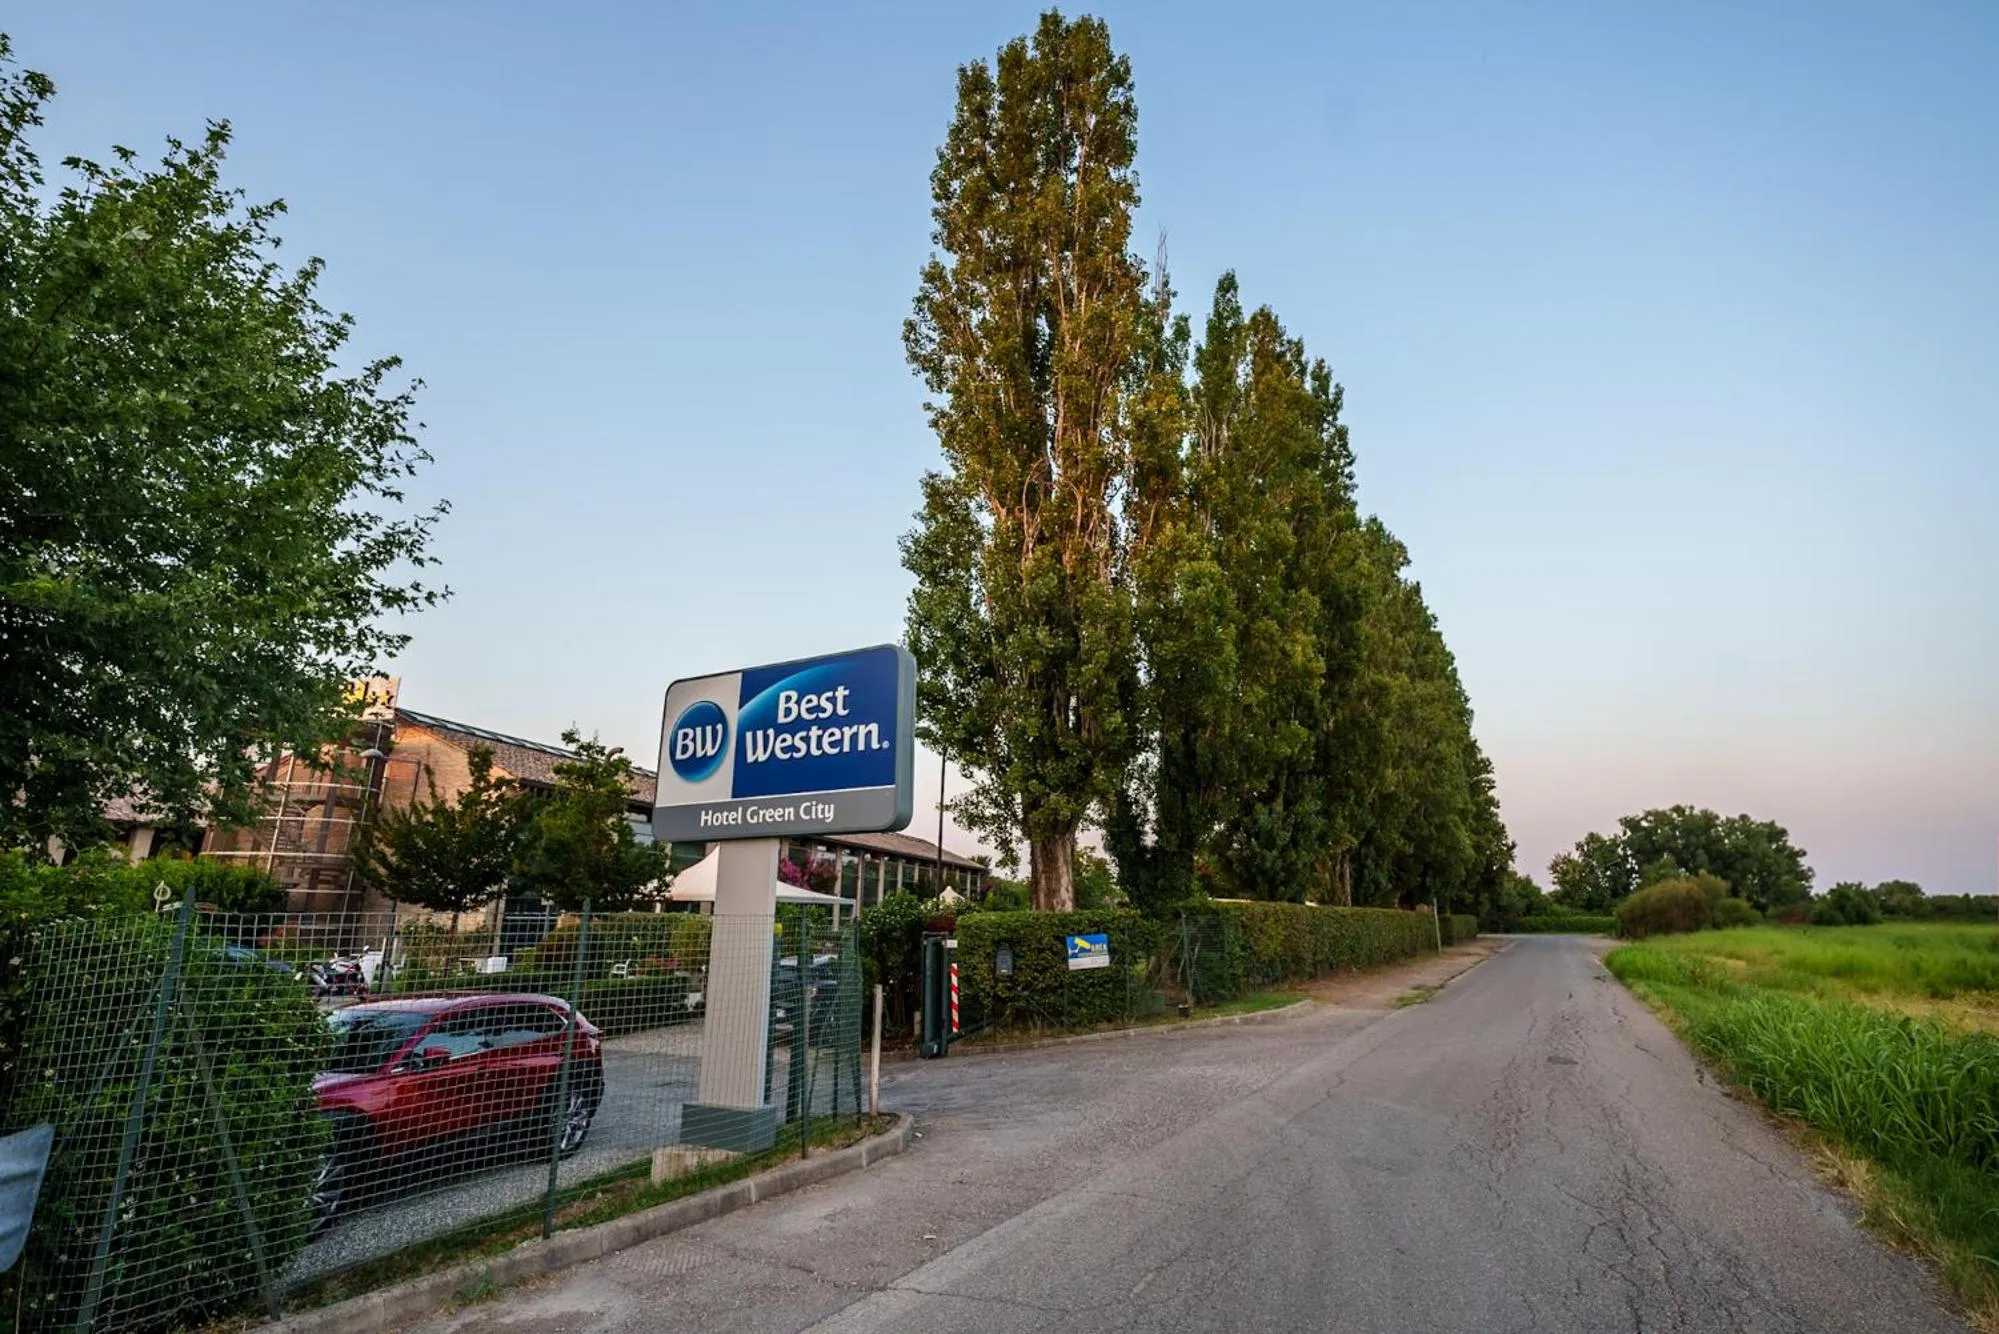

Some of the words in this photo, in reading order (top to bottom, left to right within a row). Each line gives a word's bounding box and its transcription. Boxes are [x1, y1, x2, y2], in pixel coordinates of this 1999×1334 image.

[776, 686, 850, 724] Best
[674, 722, 723, 761] BW
[700, 806, 742, 827] Hotel
[746, 803, 795, 824] Green
[799, 800, 835, 823] City
